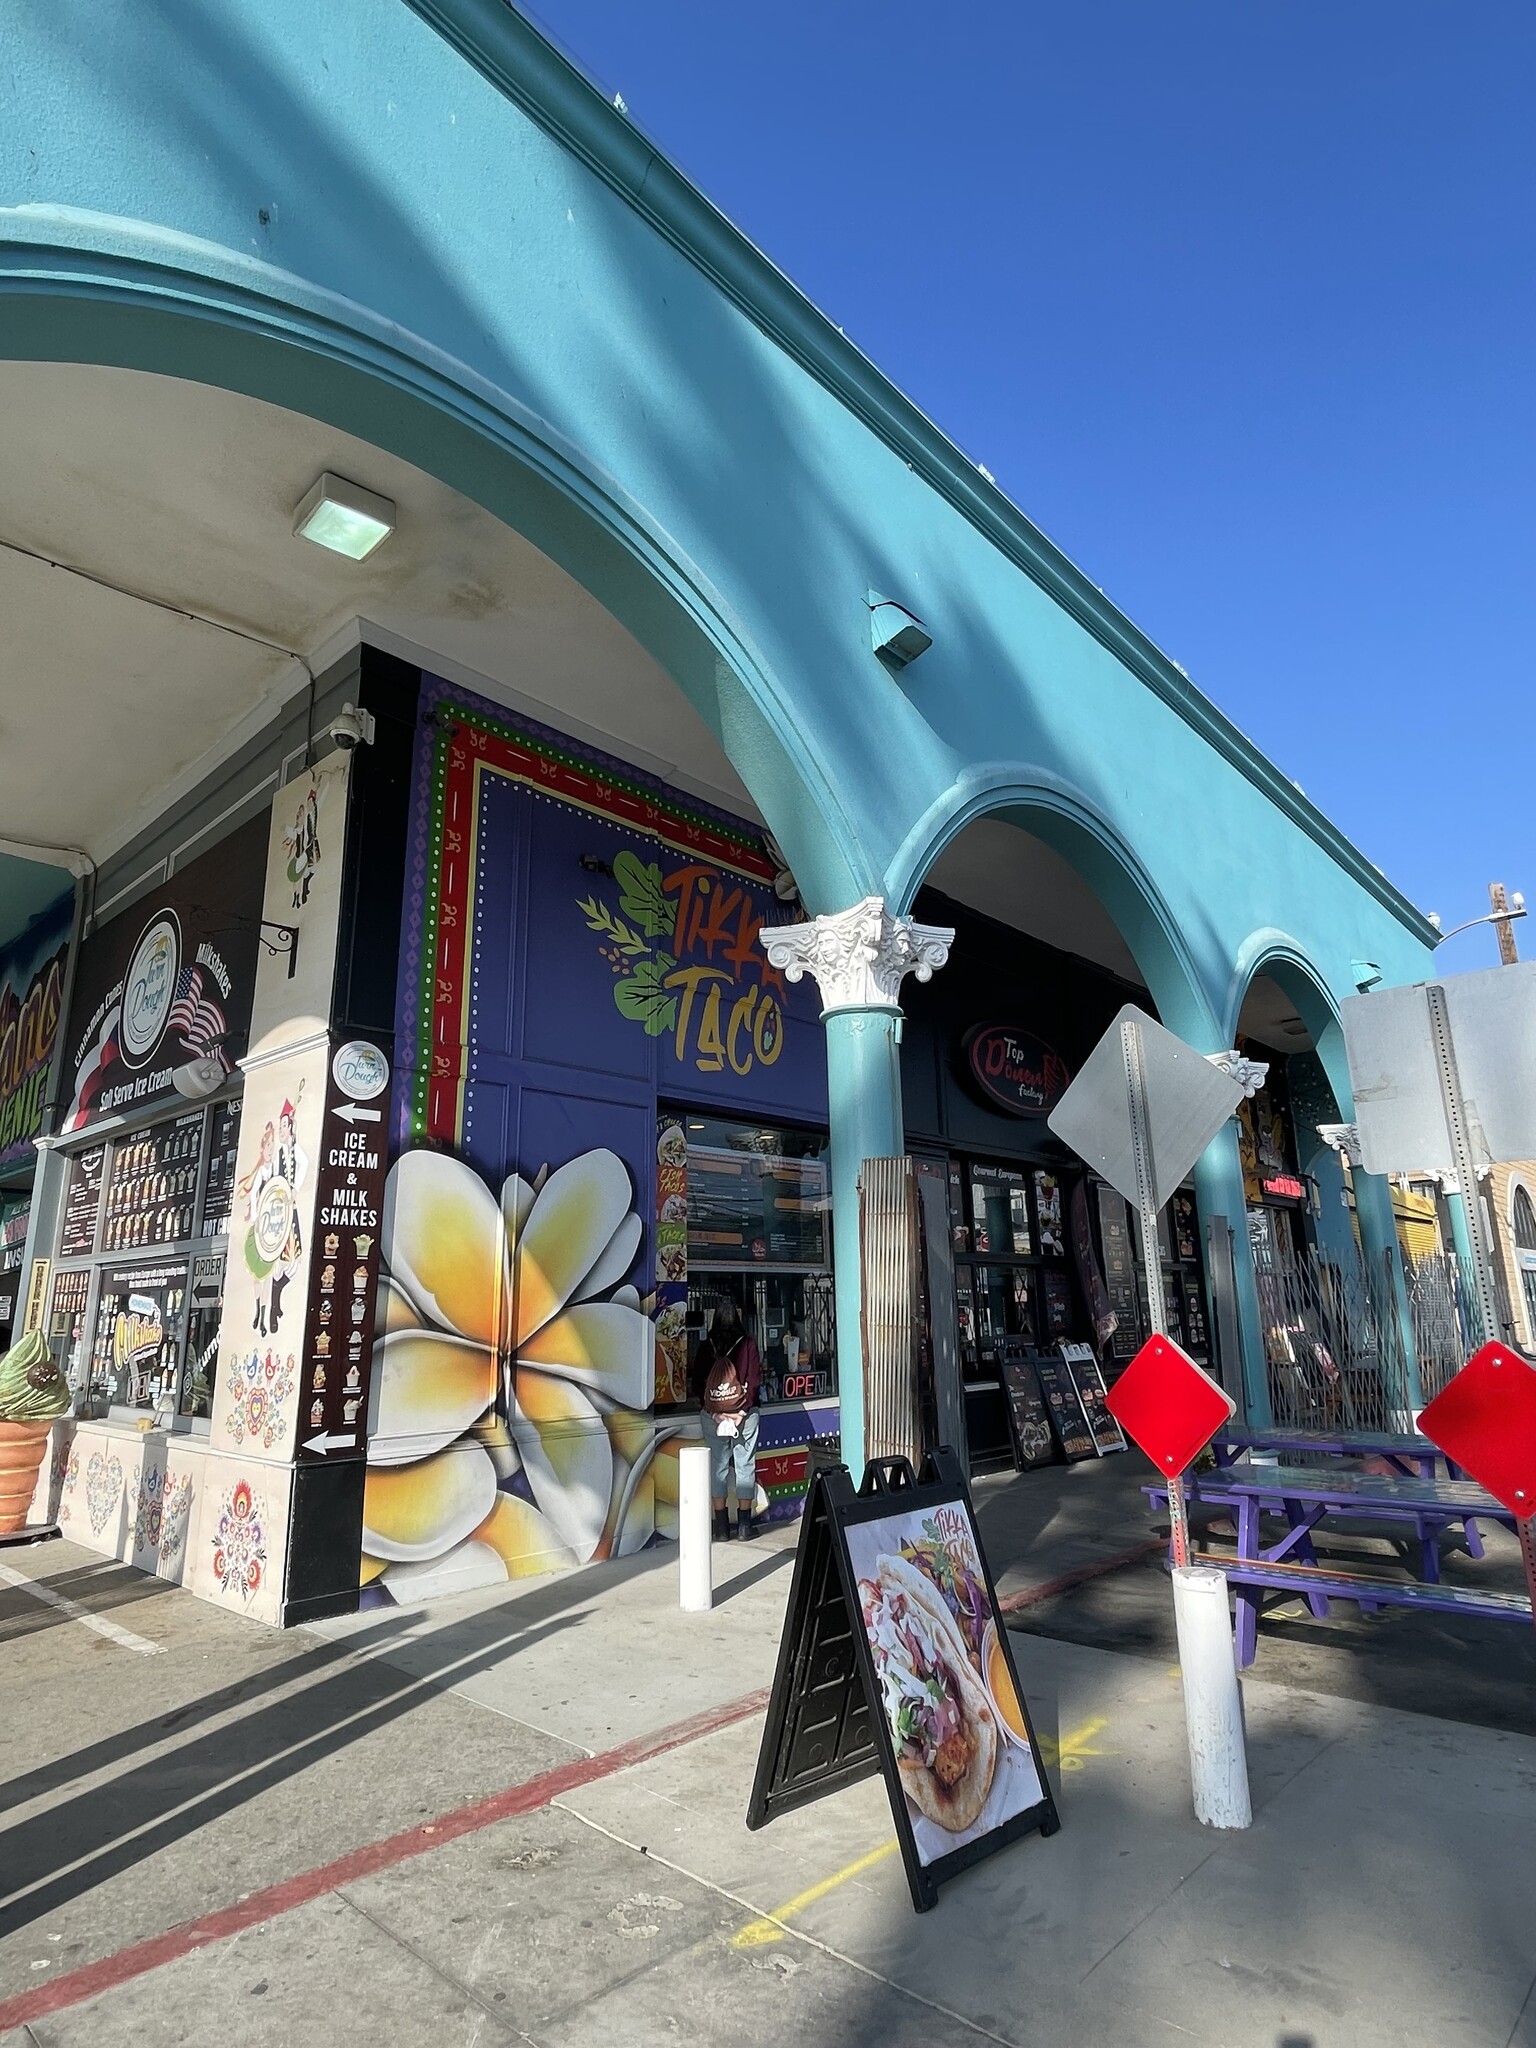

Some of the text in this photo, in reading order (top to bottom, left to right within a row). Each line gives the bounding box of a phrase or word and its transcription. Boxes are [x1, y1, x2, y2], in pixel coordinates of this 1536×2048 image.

[195, 941, 232, 1000] Milkshakes
[131, 978, 166, 1018] Dough
[663, 964, 784, 1075] TACO
[1003, 1036, 1025, 1065] Top
[339, 1062, 380, 1084] Dough
[114, 1077, 133, 1106] Serve
[133, 1072, 147, 1097] Ice
[148, 1066, 174, 1092] Cream
[344, 1131, 367, 1150] ICE
[329, 1149, 379, 1170] CREAM
[346, 1172, 358, 1186] &
[659, 1167, 683, 1182] FISH
[659, 1178, 686, 1194] TACOS
[332, 1188, 368, 1208] MILK
[320, 1207, 378, 1228] SHAKES
[194, 1257, 222, 1277] ORDER
[784, 1374, 826, 1399] OPEN
